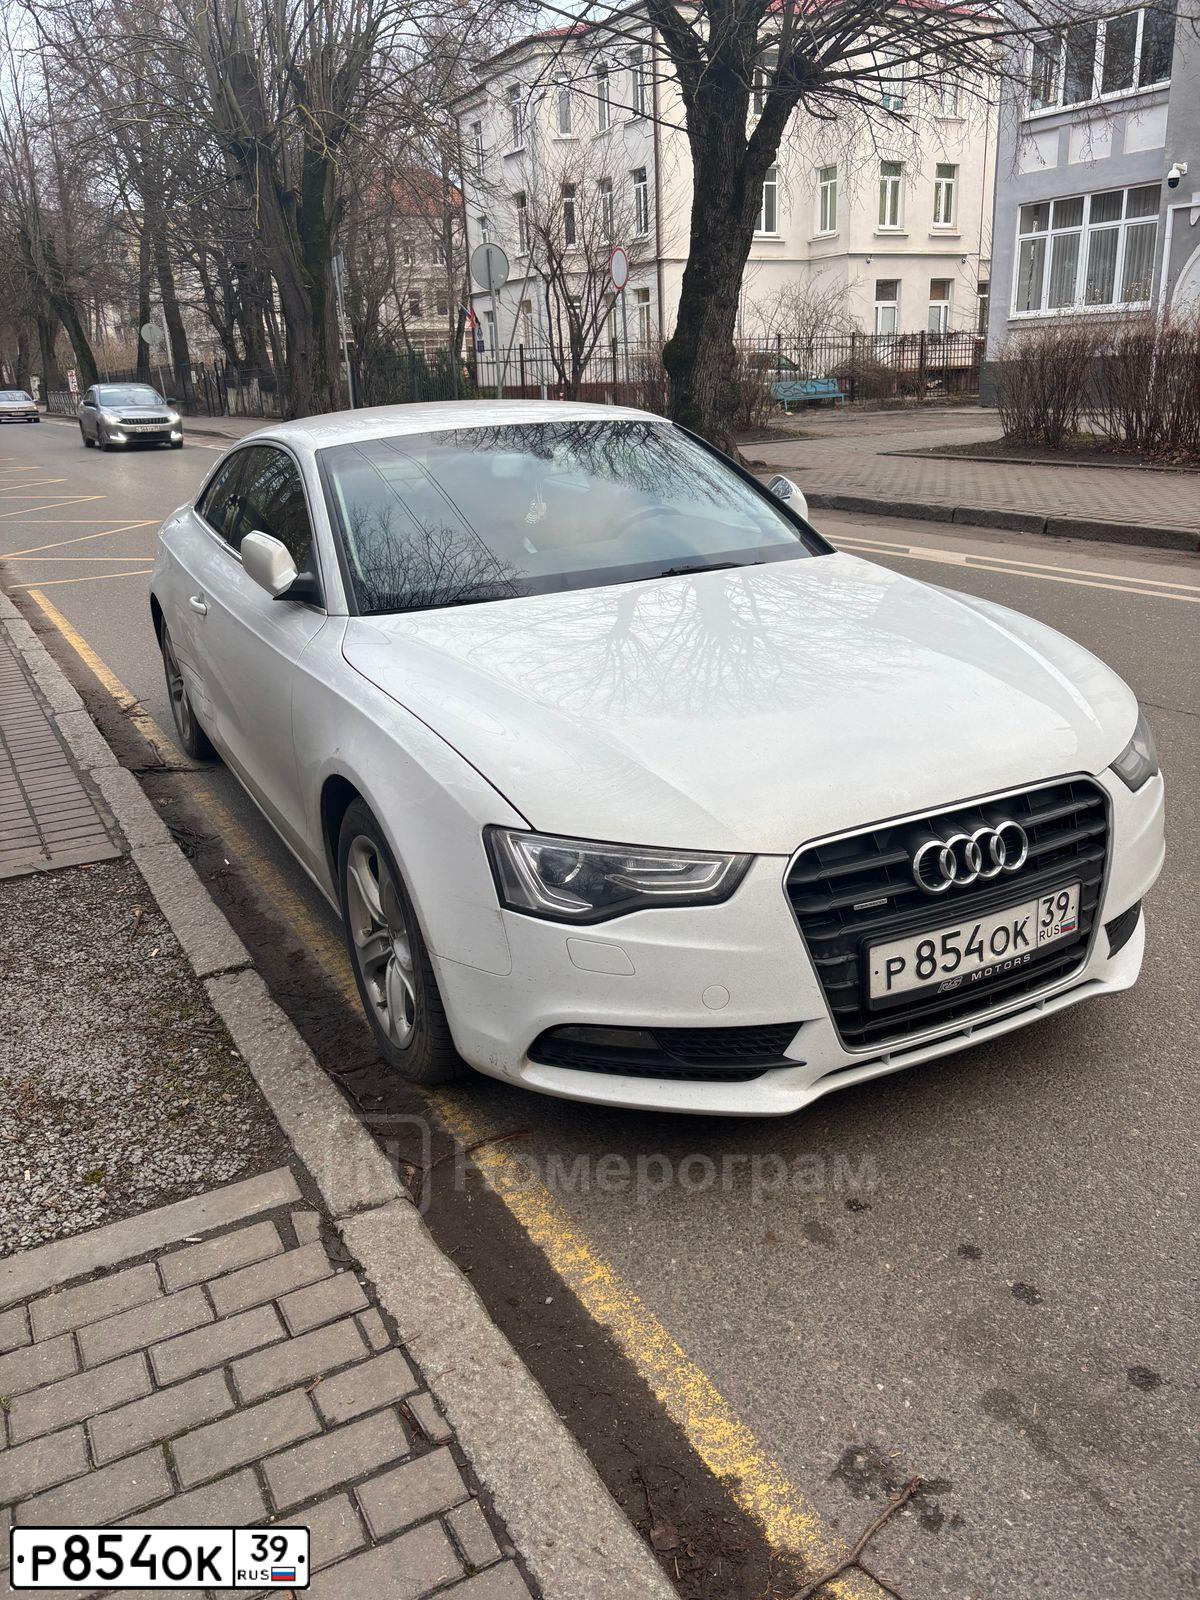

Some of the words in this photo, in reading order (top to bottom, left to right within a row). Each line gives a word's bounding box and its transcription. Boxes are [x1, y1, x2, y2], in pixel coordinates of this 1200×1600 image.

[1041, 891, 1070, 928] 39
[1039, 924, 1060, 941] RUS
[971, 953, 1031, 981] MOTORS
